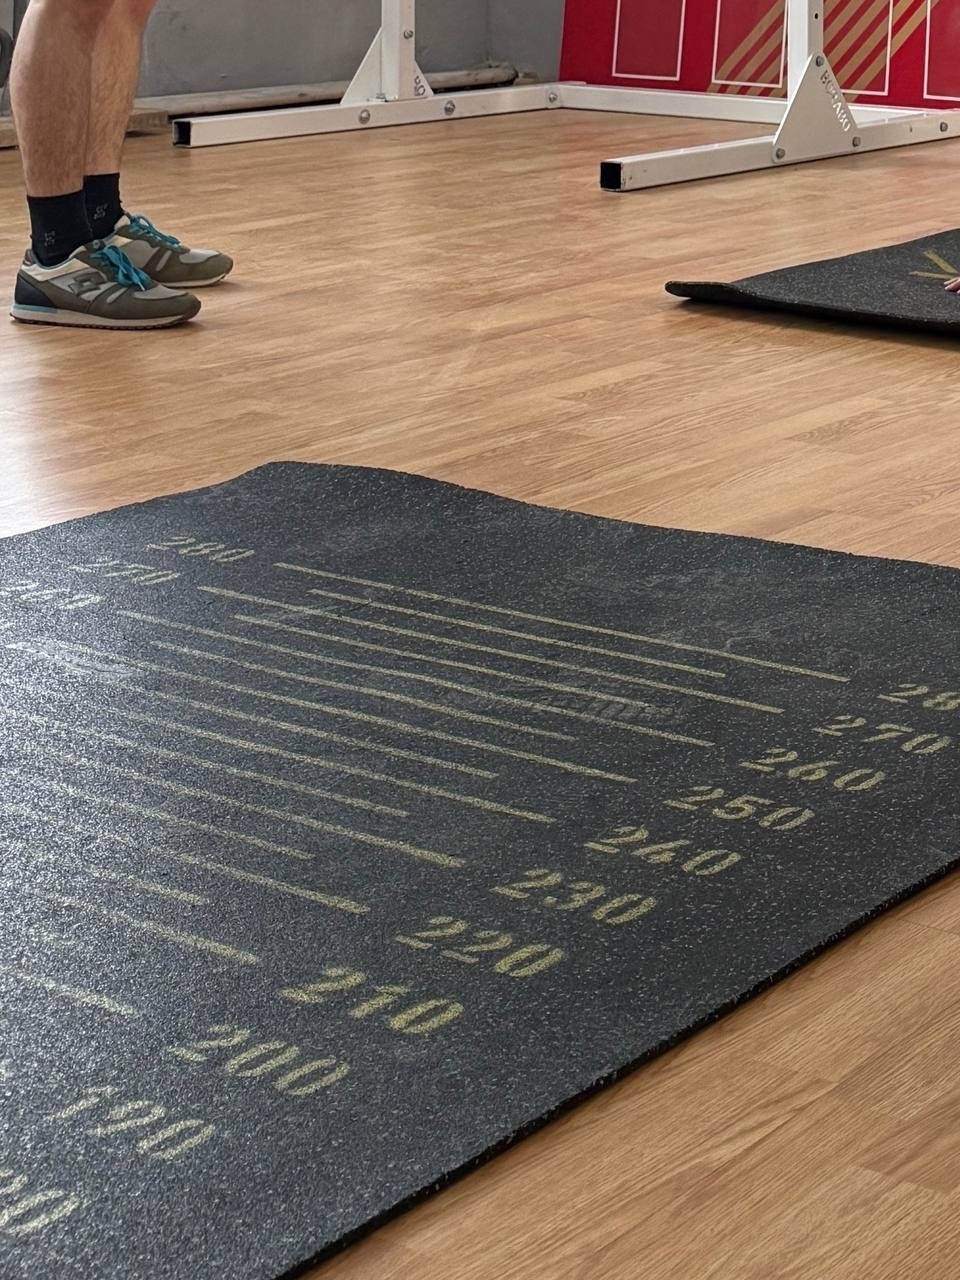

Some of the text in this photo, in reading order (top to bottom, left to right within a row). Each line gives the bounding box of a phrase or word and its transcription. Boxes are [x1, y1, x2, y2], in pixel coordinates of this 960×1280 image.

[147, 536, 255, 563] 280
[813, 715, 952, 755] 270
[738, 748, 886, 792] 260
[663, 786, 815, 831] 250
[584, 825, 742, 876] 240
[491, 868, 656, 925] 230
[394, 917, 565, 977] 220
[276, 964, 465, 1034] 210
[166, 1024, 350, 1097] 200
[50, 1085, 216, 1160] 190
